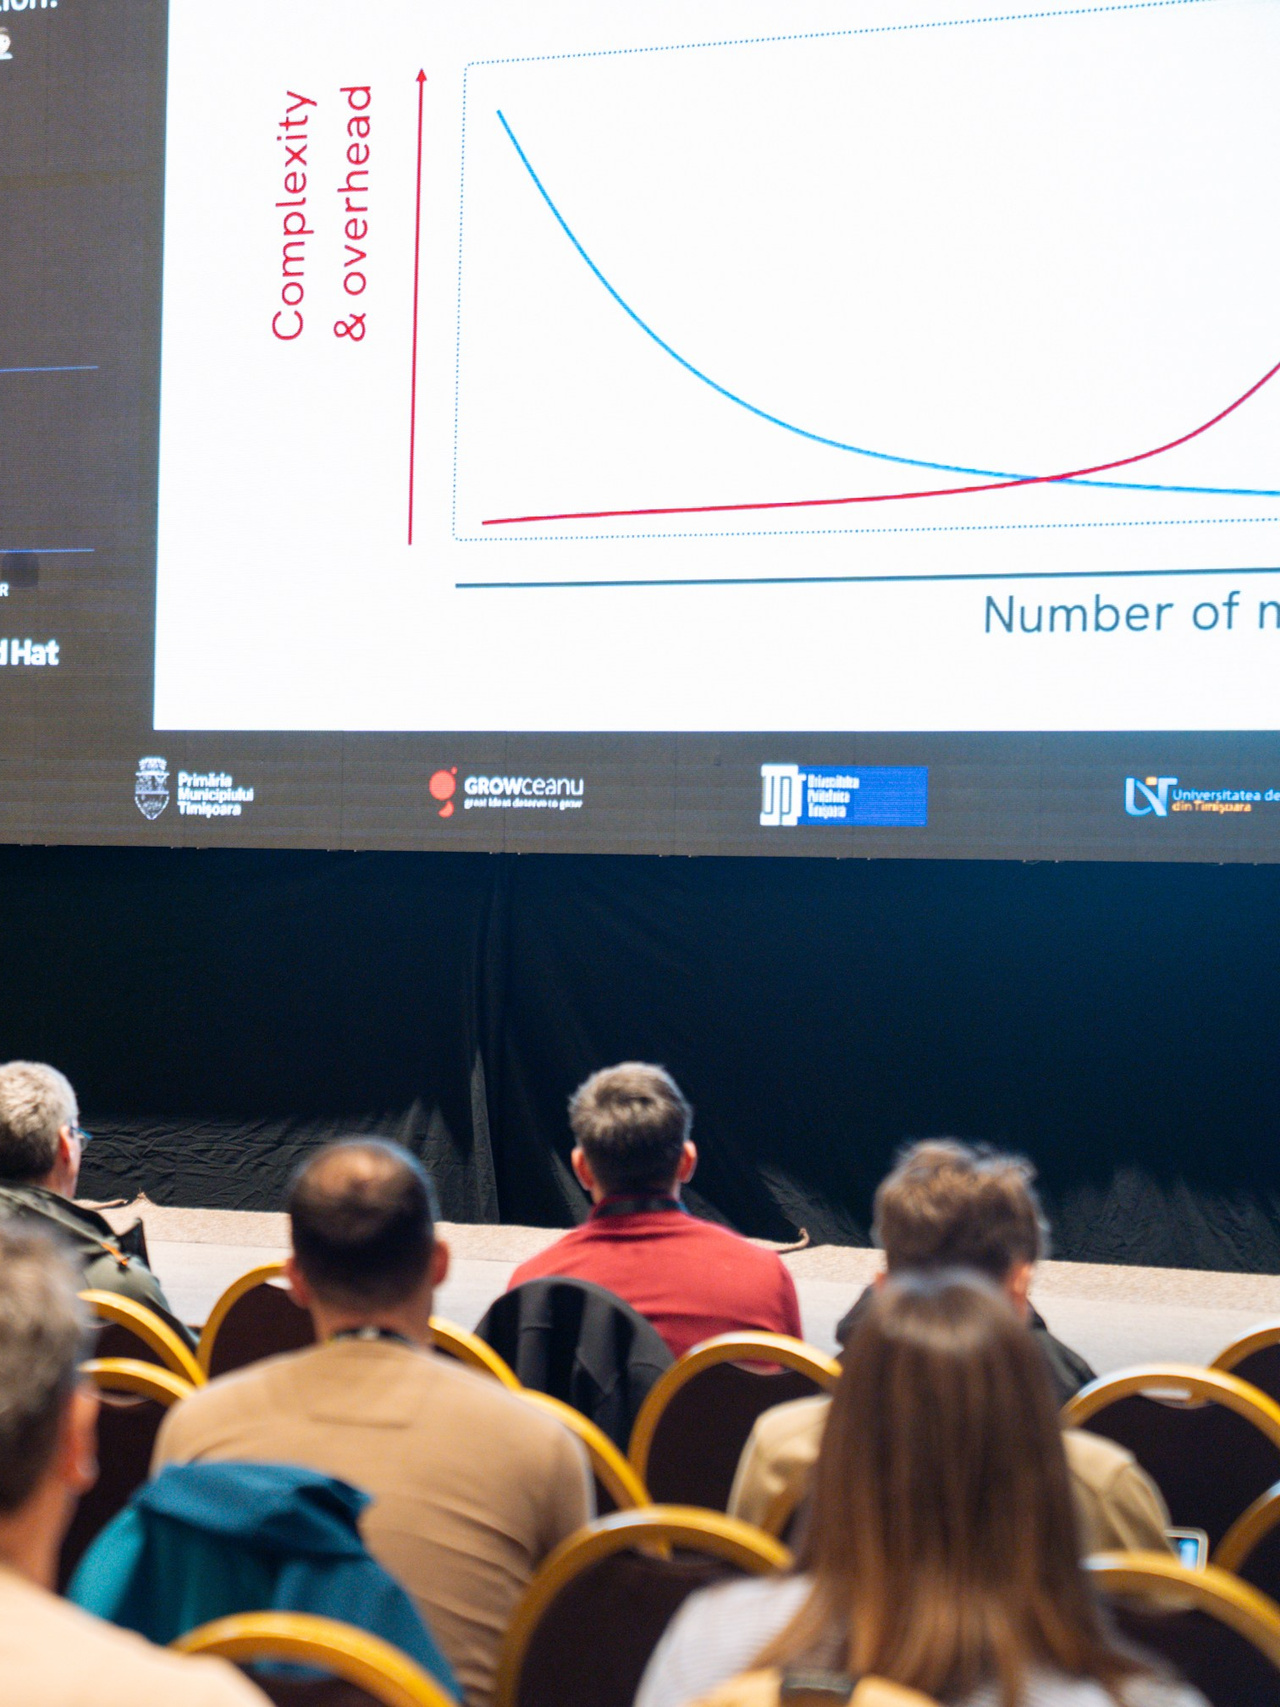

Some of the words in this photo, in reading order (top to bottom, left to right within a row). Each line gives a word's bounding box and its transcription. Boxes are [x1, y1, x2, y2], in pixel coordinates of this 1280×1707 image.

[336, 85, 372, 296] overhead
[271, 90, 318, 341] Complexity
[333, 312, 367, 342] &
[985, 593, 1175, 634] Number
[1192, 590, 1241, 631] of
[10, 638, 61, 666] Hat
[1172, 787, 1262, 801] Universitatea
